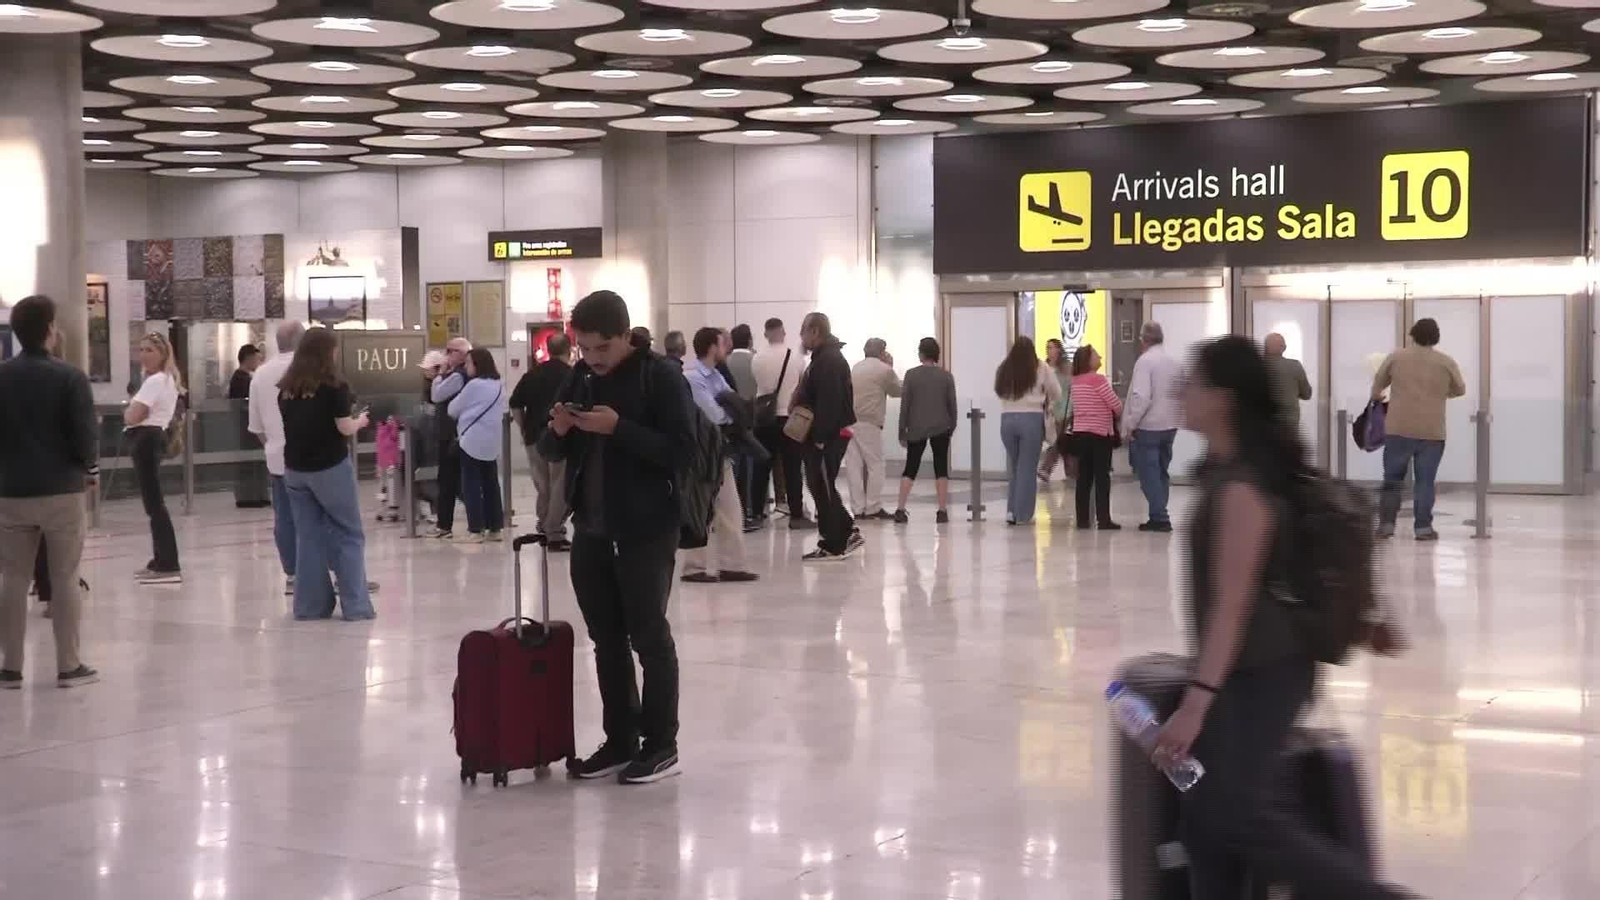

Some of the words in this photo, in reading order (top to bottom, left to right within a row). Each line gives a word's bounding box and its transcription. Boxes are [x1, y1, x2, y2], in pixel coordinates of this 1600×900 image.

[1112, 169, 1219, 202] Arrivals
[1231, 164, 1285, 197] hall
[1388, 167, 1462, 225] 10
[1112, 208, 1263, 251] Llegadas
[1277, 204, 1356, 240] Sala
